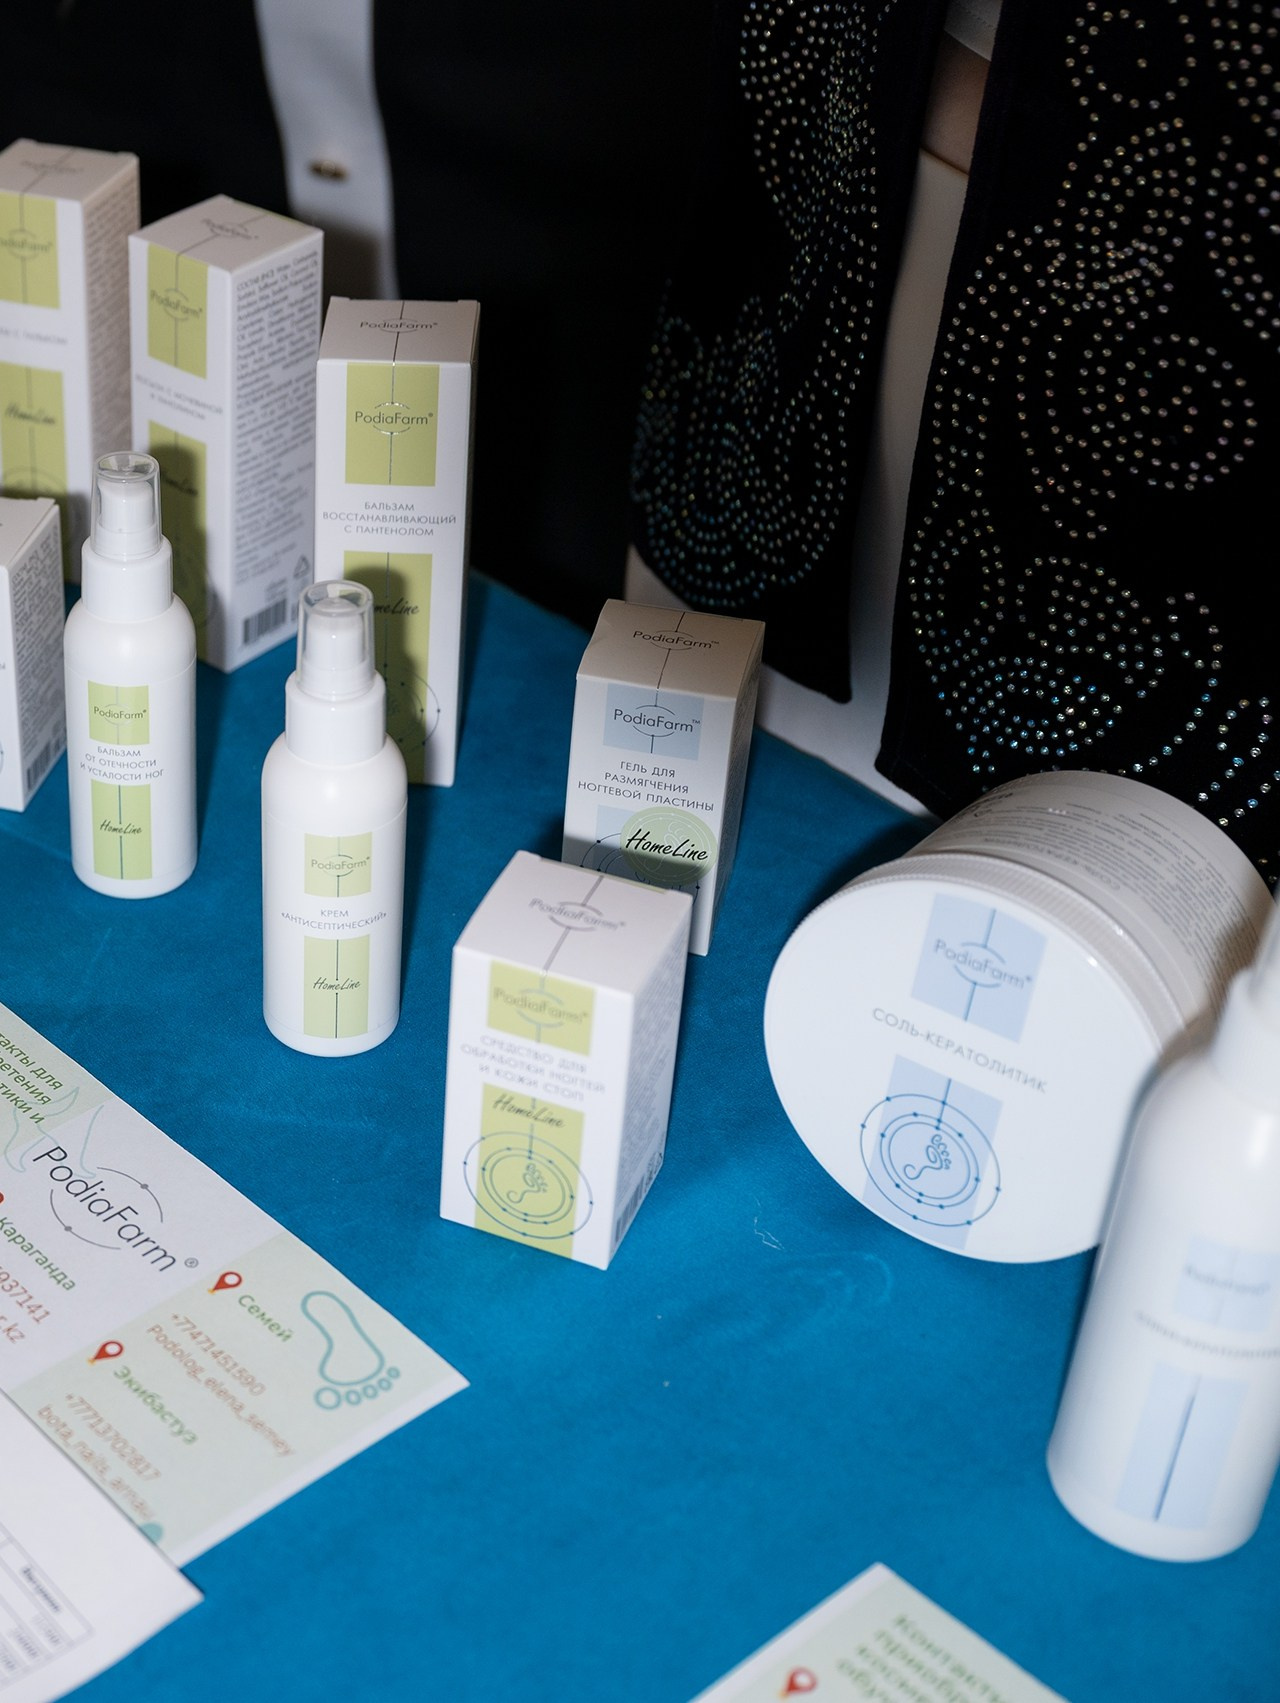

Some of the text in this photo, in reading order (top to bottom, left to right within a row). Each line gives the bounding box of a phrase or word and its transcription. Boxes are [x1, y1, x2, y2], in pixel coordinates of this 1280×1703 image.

[364, 501, 415, 512] БАЛЬЗАМ
[323, 511, 457, 525] ВОССТАНАВЛИВАЮЩИЙ
[344, 525, 434, 536] С ПАНТЕНОЛОМ
[97, 746, 141, 757] БАЛЬЗАМ
[85, 753, 157, 770] ОТ ОТЕЧНОСТИ
[87, 766, 142, 781] УСТАЛОСТИ
[145, 769, 164, 779] НОГ
[620, 761, 676, 779] ГЕЛЬ ДЛЯ
[604, 772, 689, 794] РАЗМЯГЧЕНИЯ
[578, 781, 715, 812] НОГТЕВОЙ ПЛАСТИНЫ
[100, 819, 142, 835] HomeLine
[625, 828, 709, 861] HomeLine
[320, 909, 349, 918] КРЕМ
[313, 976, 361, 991] HomeLine
[872, 1006, 1048, 1095] СОЛЬ-КЕРАТОЛИТИК
[31, 1063, 63, 1090] для
[29, 1112, 45, 1124] и
[238, 1294, 294, 1343] Семей
[113, 1365, 199, 1445] Экибастуз
